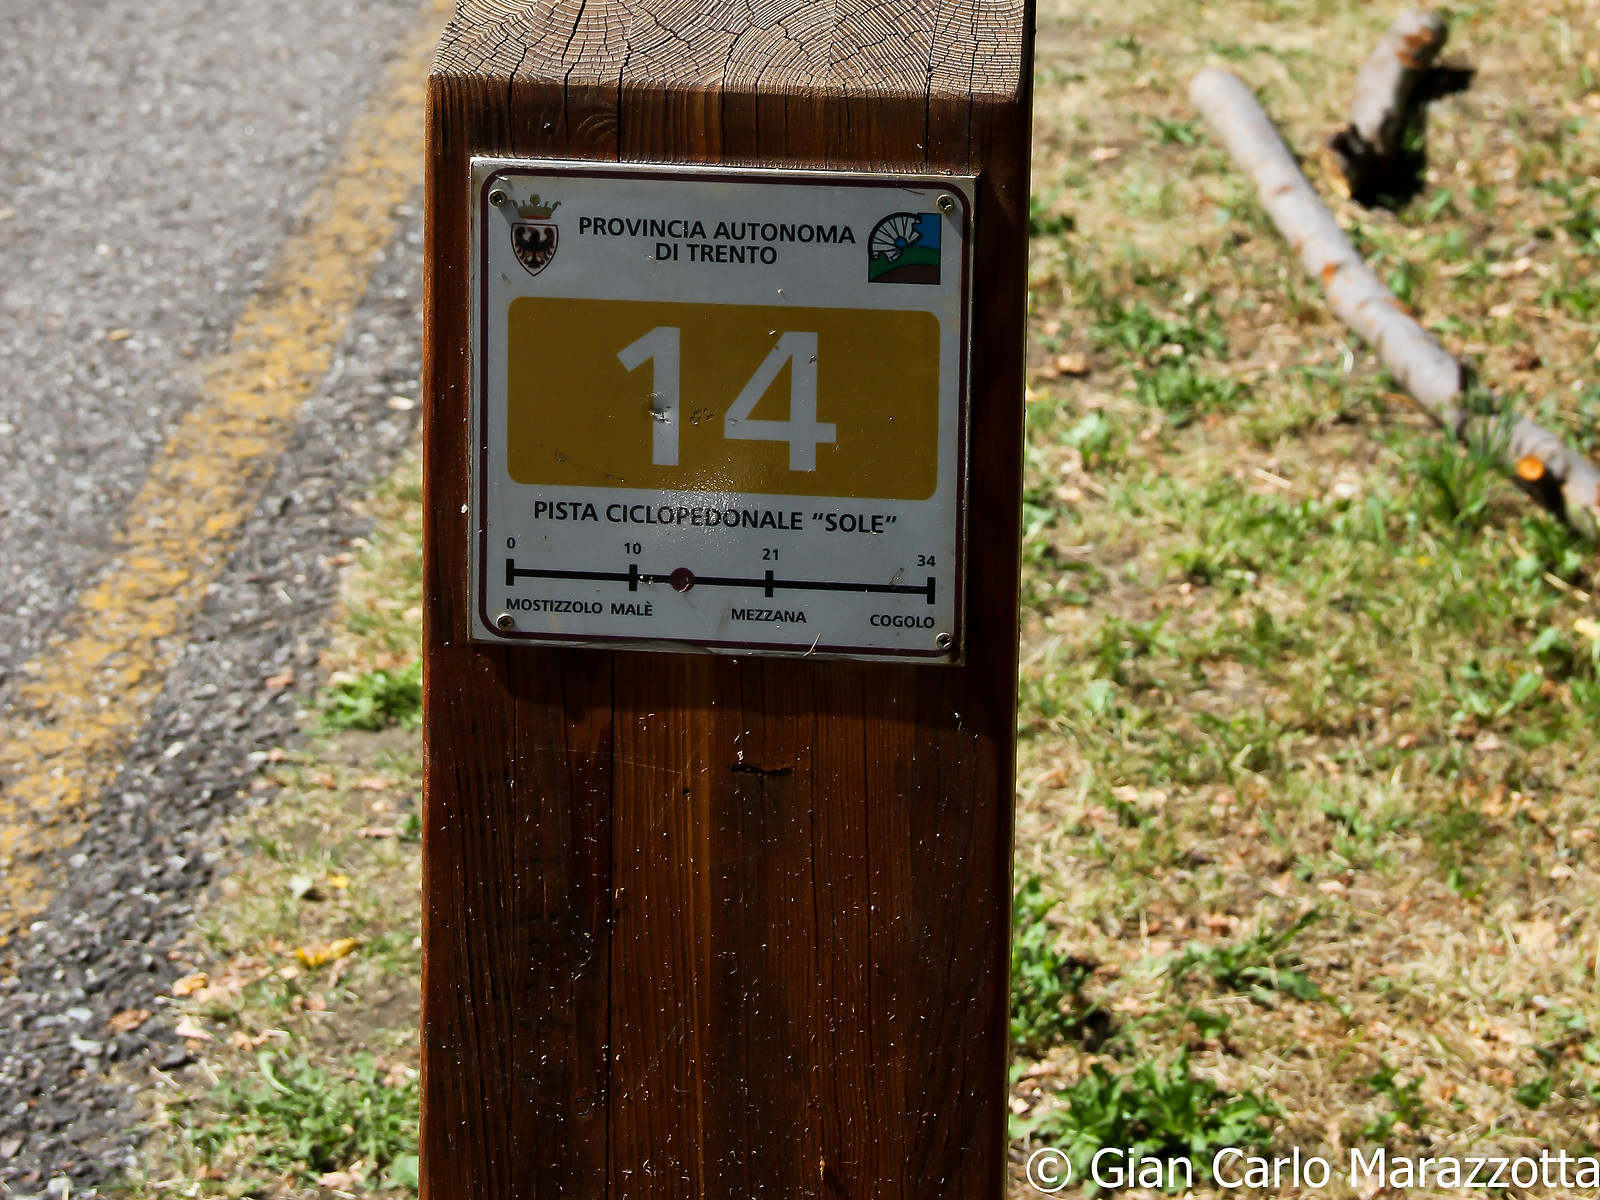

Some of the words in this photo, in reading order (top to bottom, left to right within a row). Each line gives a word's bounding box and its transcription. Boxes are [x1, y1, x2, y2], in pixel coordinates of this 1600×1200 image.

[578, 216, 705, 240] PROVINCIA
[713, 221, 856, 245] AUTONOMA
[655, 242, 679, 261] DI
[686, 243, 777, 265] TRENTO
[616, 326, 836, 472] 14
[533, 500, 599, 522] PISTA
[605, 503, 803, 531] CICLOPEDONALE
[506, 537, 516, 549] 0
[624, 542, 642, 555] 10
[762, 548, 779, 561] 21
[917, 555, 936, 567] 34
[506, 598, 603, 614] MOSTIZZOLO
[611, 601, 653, 616] MALÈ
[731, 608, 807, 624] MEZZANA
[870, 614, 935, 629] COGOLO
